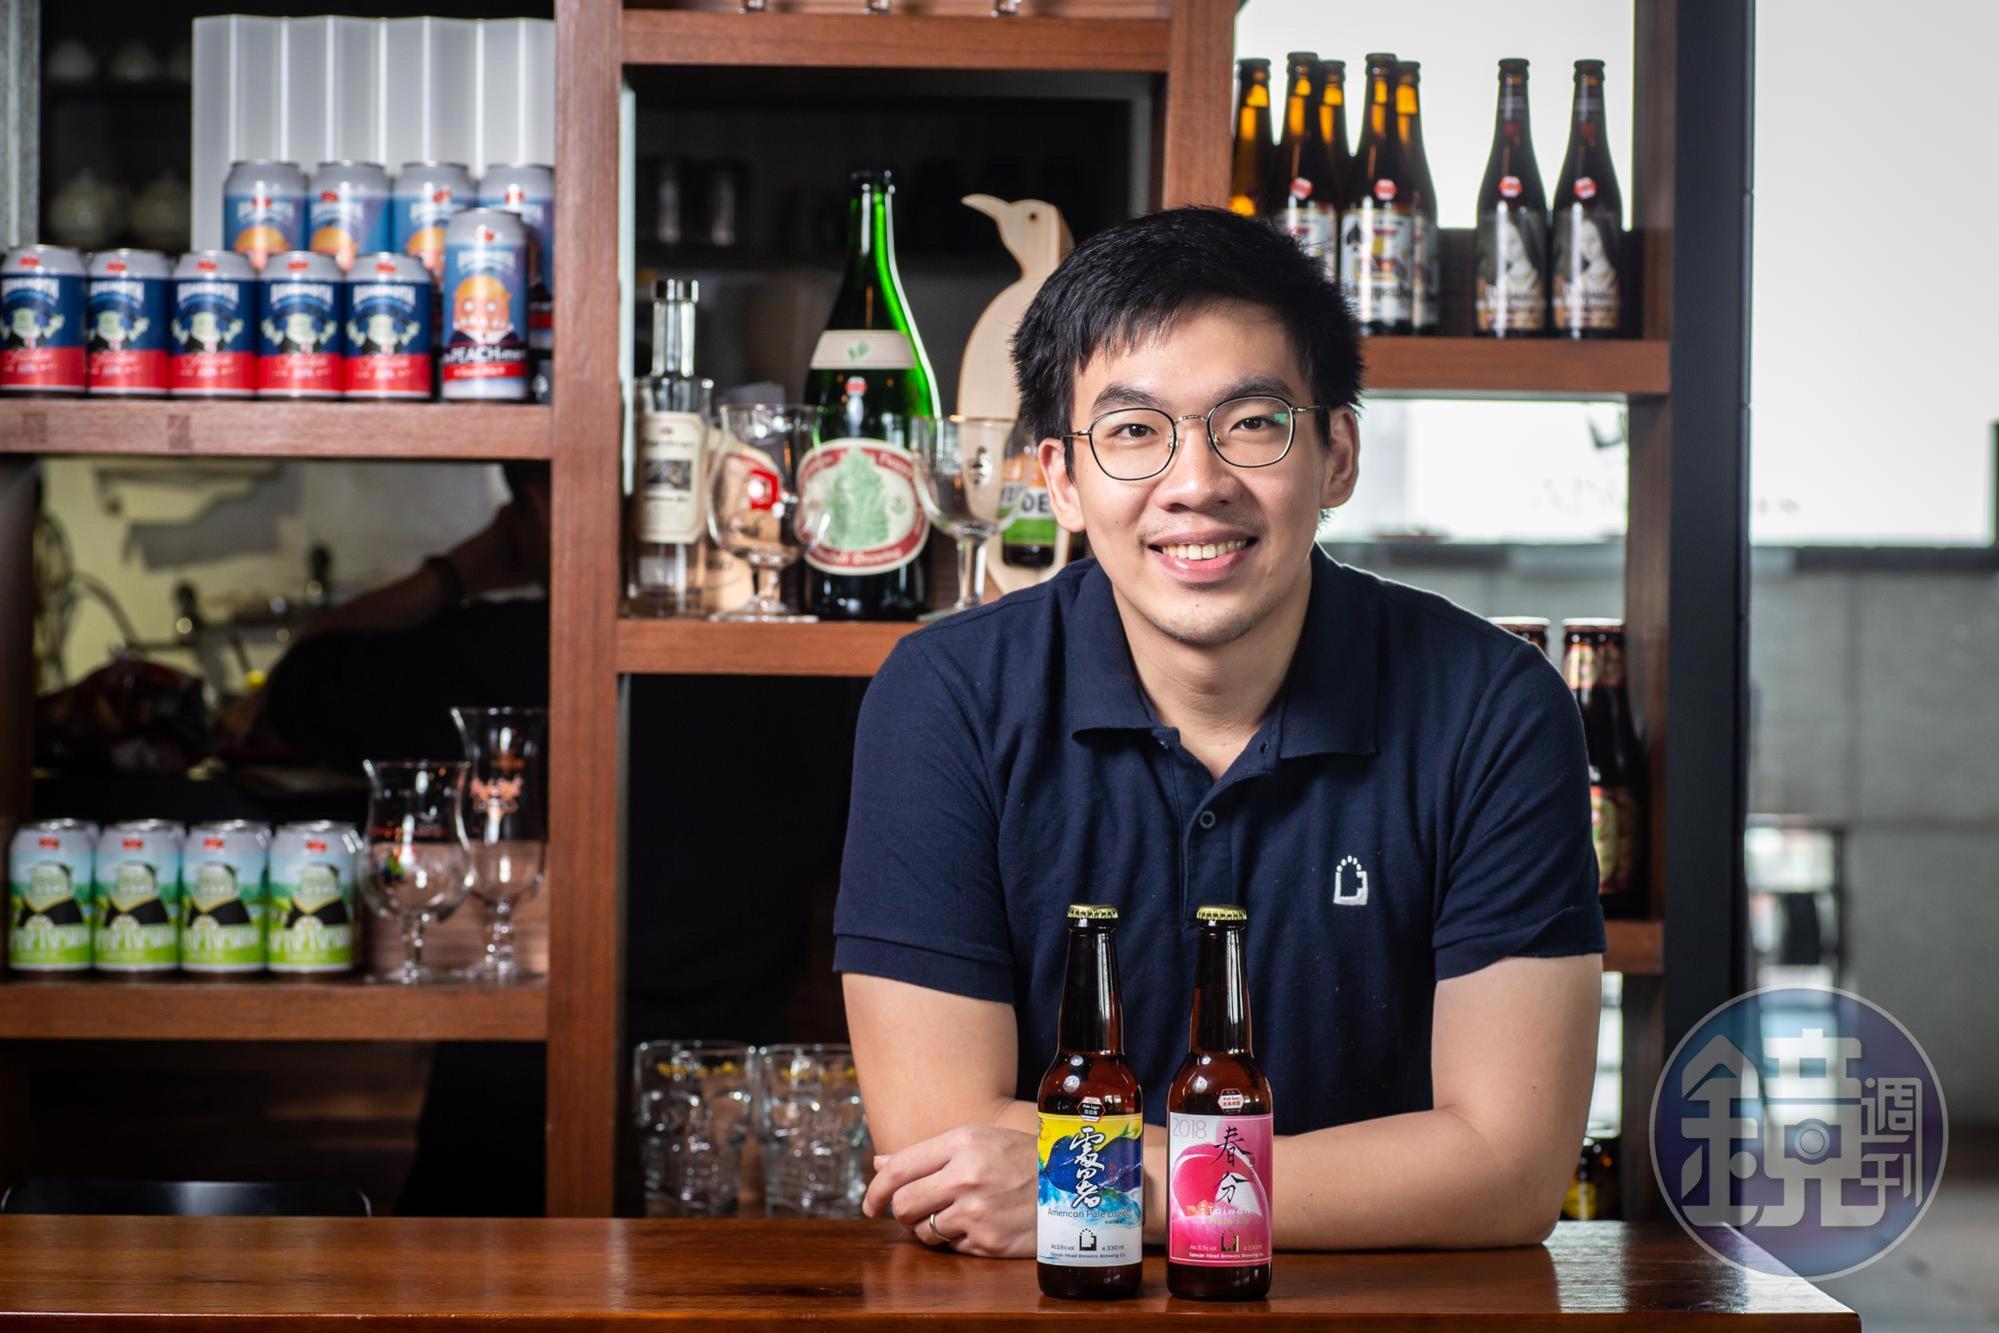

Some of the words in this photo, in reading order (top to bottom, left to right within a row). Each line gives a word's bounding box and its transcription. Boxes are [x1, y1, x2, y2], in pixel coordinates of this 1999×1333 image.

[1172, 1117, 1207, 1139] 2018
[1209, 1125, 1253, 1204] 春分
[1048, 1208, 1085, 1218] American
[1087, 1210, 1105, 1218] Pale
[1208, 1206, 1250, 1215] Taiwan
